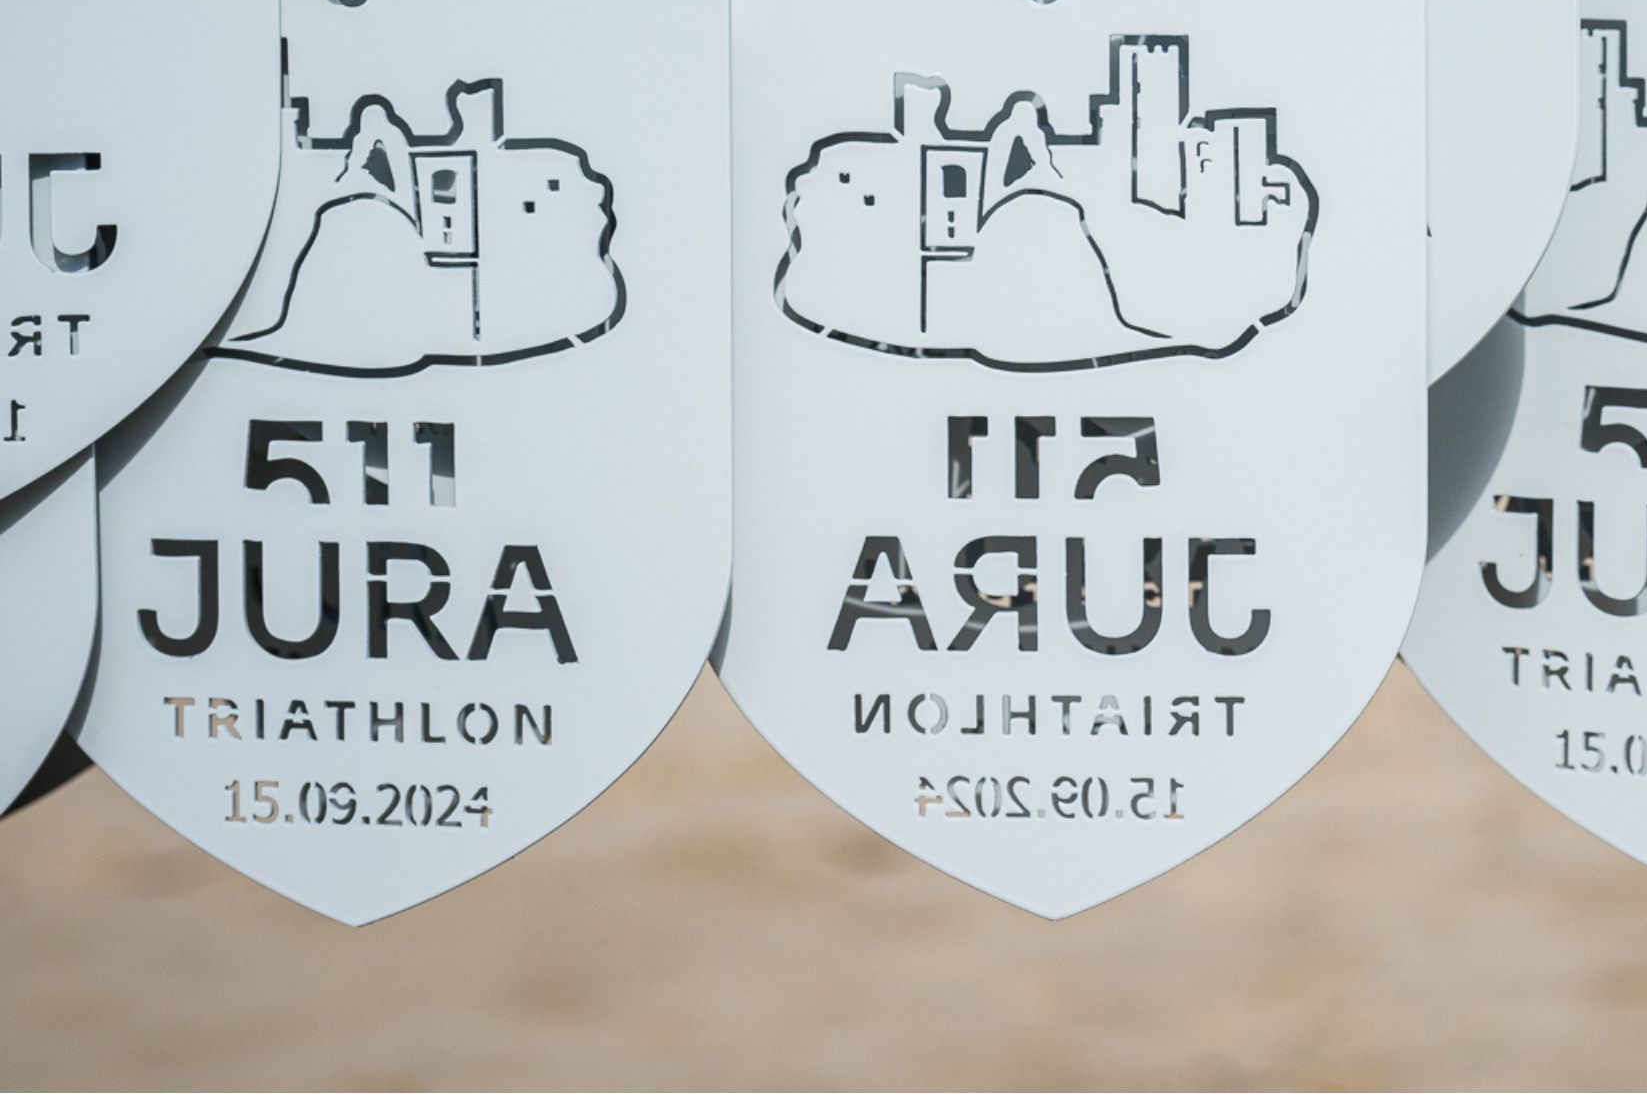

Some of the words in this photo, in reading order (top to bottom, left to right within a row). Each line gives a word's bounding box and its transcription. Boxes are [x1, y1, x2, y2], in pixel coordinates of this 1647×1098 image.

[242, 418, 458, 507] 511
[136, 538, 579, 665] JURA
[163, 696, 554, 746] TRIATHLON
[223, 779, 494, 828] 15.09.2024
